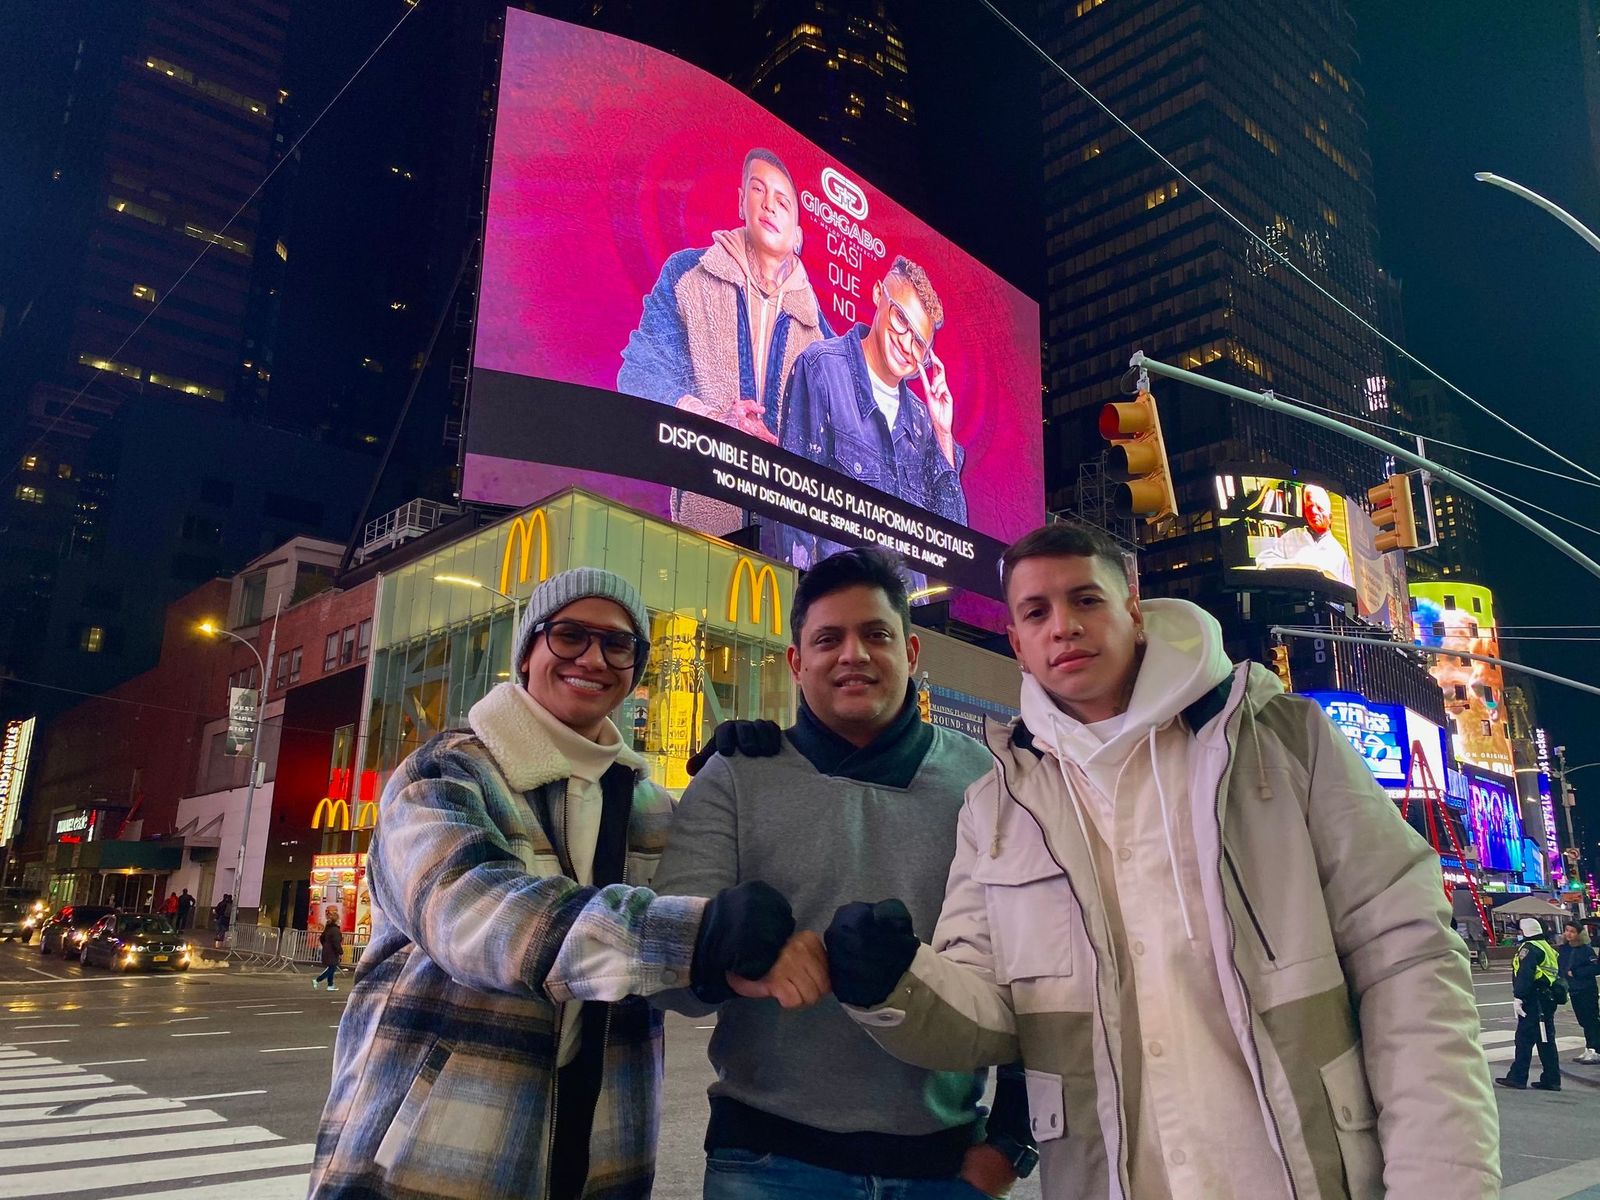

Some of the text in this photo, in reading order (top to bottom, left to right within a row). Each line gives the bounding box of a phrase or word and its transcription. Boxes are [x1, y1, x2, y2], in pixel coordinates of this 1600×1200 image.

[827, 232, 862, 271] CASI
[828, 262, 861, 299] QUE
[833, 292, 856, 322] NO
[658, 423, 975, 560] DISPONIBLE EN TODAS LAS PLATAFORMAS DIGITALES
[737, 477, 758, 497] HAY
[759, 486, 808, 517] DISTANCIA
[809, 506, 829, 525] QUE
[830, 513, 863, 540] SEPARE,
[863, 526, 876, 542] LO
[876, 532, 895, 550] QUE
[895, 538, 911, 556] UNE
[911, 545, 921, 560] EL
